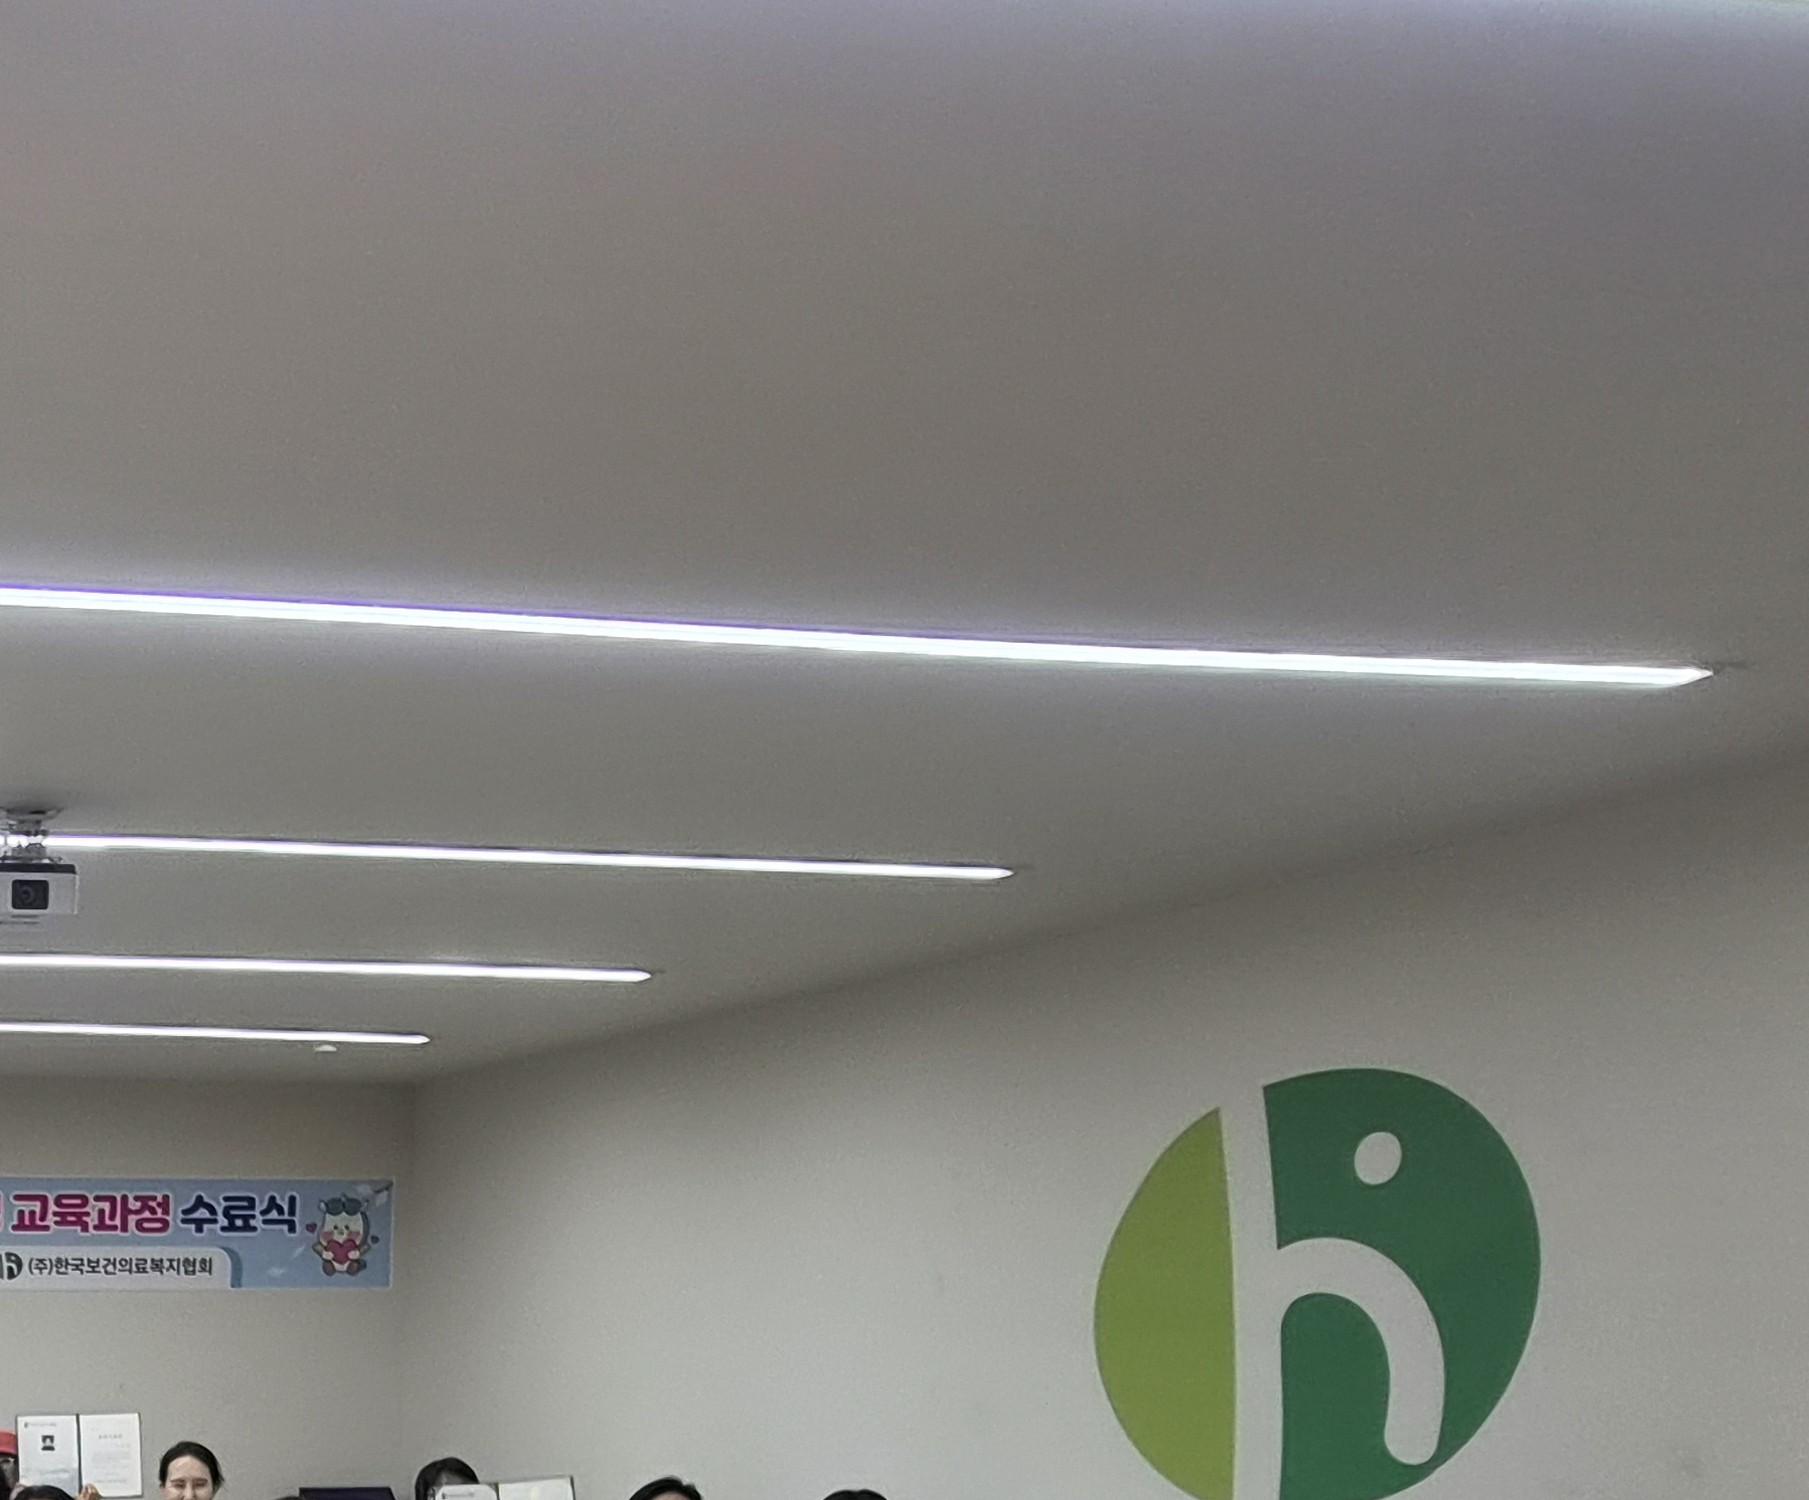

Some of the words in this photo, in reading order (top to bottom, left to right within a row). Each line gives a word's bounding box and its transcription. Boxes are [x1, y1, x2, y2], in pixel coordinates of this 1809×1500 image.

[10, 1190, 171, 1234] 교육과정
[180, 1194, 297, 1234] 수료식
[28, 1256, 213, 1277] (주)한국보건의료복지협회
